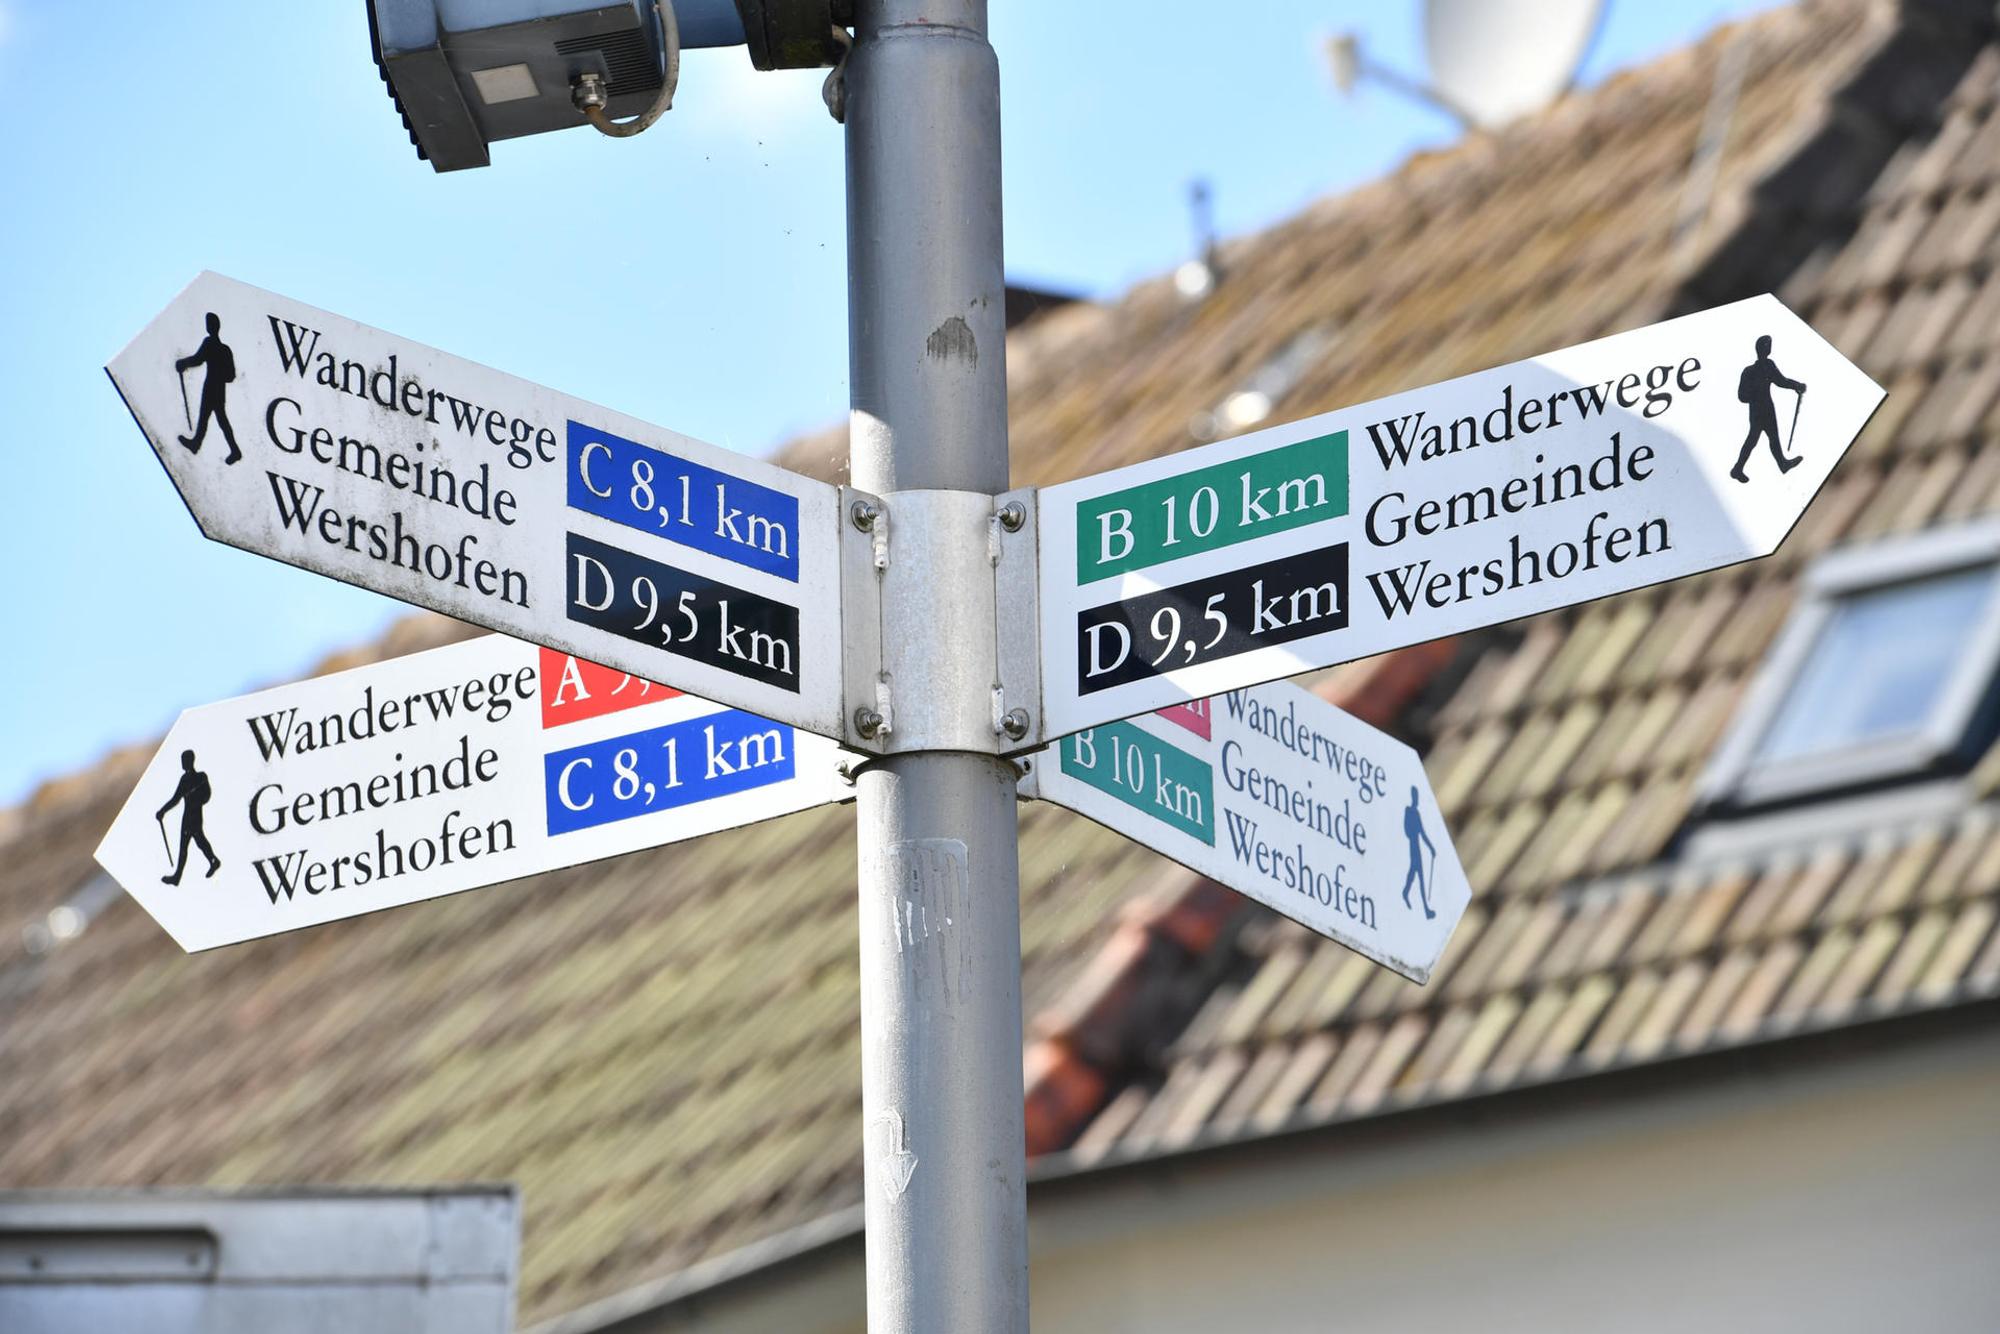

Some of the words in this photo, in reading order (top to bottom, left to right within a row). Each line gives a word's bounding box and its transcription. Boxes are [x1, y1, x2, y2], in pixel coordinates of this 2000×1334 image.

[266, 314, 558, 470] Wanderwege
[1364, 356, 1703, 473] Wanderwege
[265, 397, 518, 526] Gemeinde
[579, 442, 613, 498] C
[630, 459, 695, 528] 8,1
[714, 483, 790, 559] km
[1096, 508, 1135, 565] B
[1161, 486, 1220, 547] 10
[1238, 471, 1329, 527] km
[1364, 432, 1655, 549] Gemeinde
[265, 470, 530, 609] Wershofen
[1366, 512, 1672, 621] Wershofen
[573, 553, 615, 612] D
[631, 576, 699, 646] 9,5
[717, 600, 794, 675] km
[1084, 621, 1131, 678] D
[1150, 592, 1228, 667] 9,5
[1250, 579, 1341, 635] km
[246, 665, 537, 763] Wanderwege
[551, 655, 591, 707] A
[248, 735, 499, 836] Gemeinde
[557, 757, 595, 813] C
[612, 738, 682, 806] 8,1
[704, 724, 786, 780] km
[1073, 728, 1097, 770] B
[1111, 735, 1145, 795] 10
[1154, 753, 1204, 827] km
[1221, 740, 1367, 856] Gemeinde
[1225, 688, 1387, 803] Wanderwege
[252, 810, 517, 905] Wershofen
[1223, 807, 1378, 931] Wershofen
